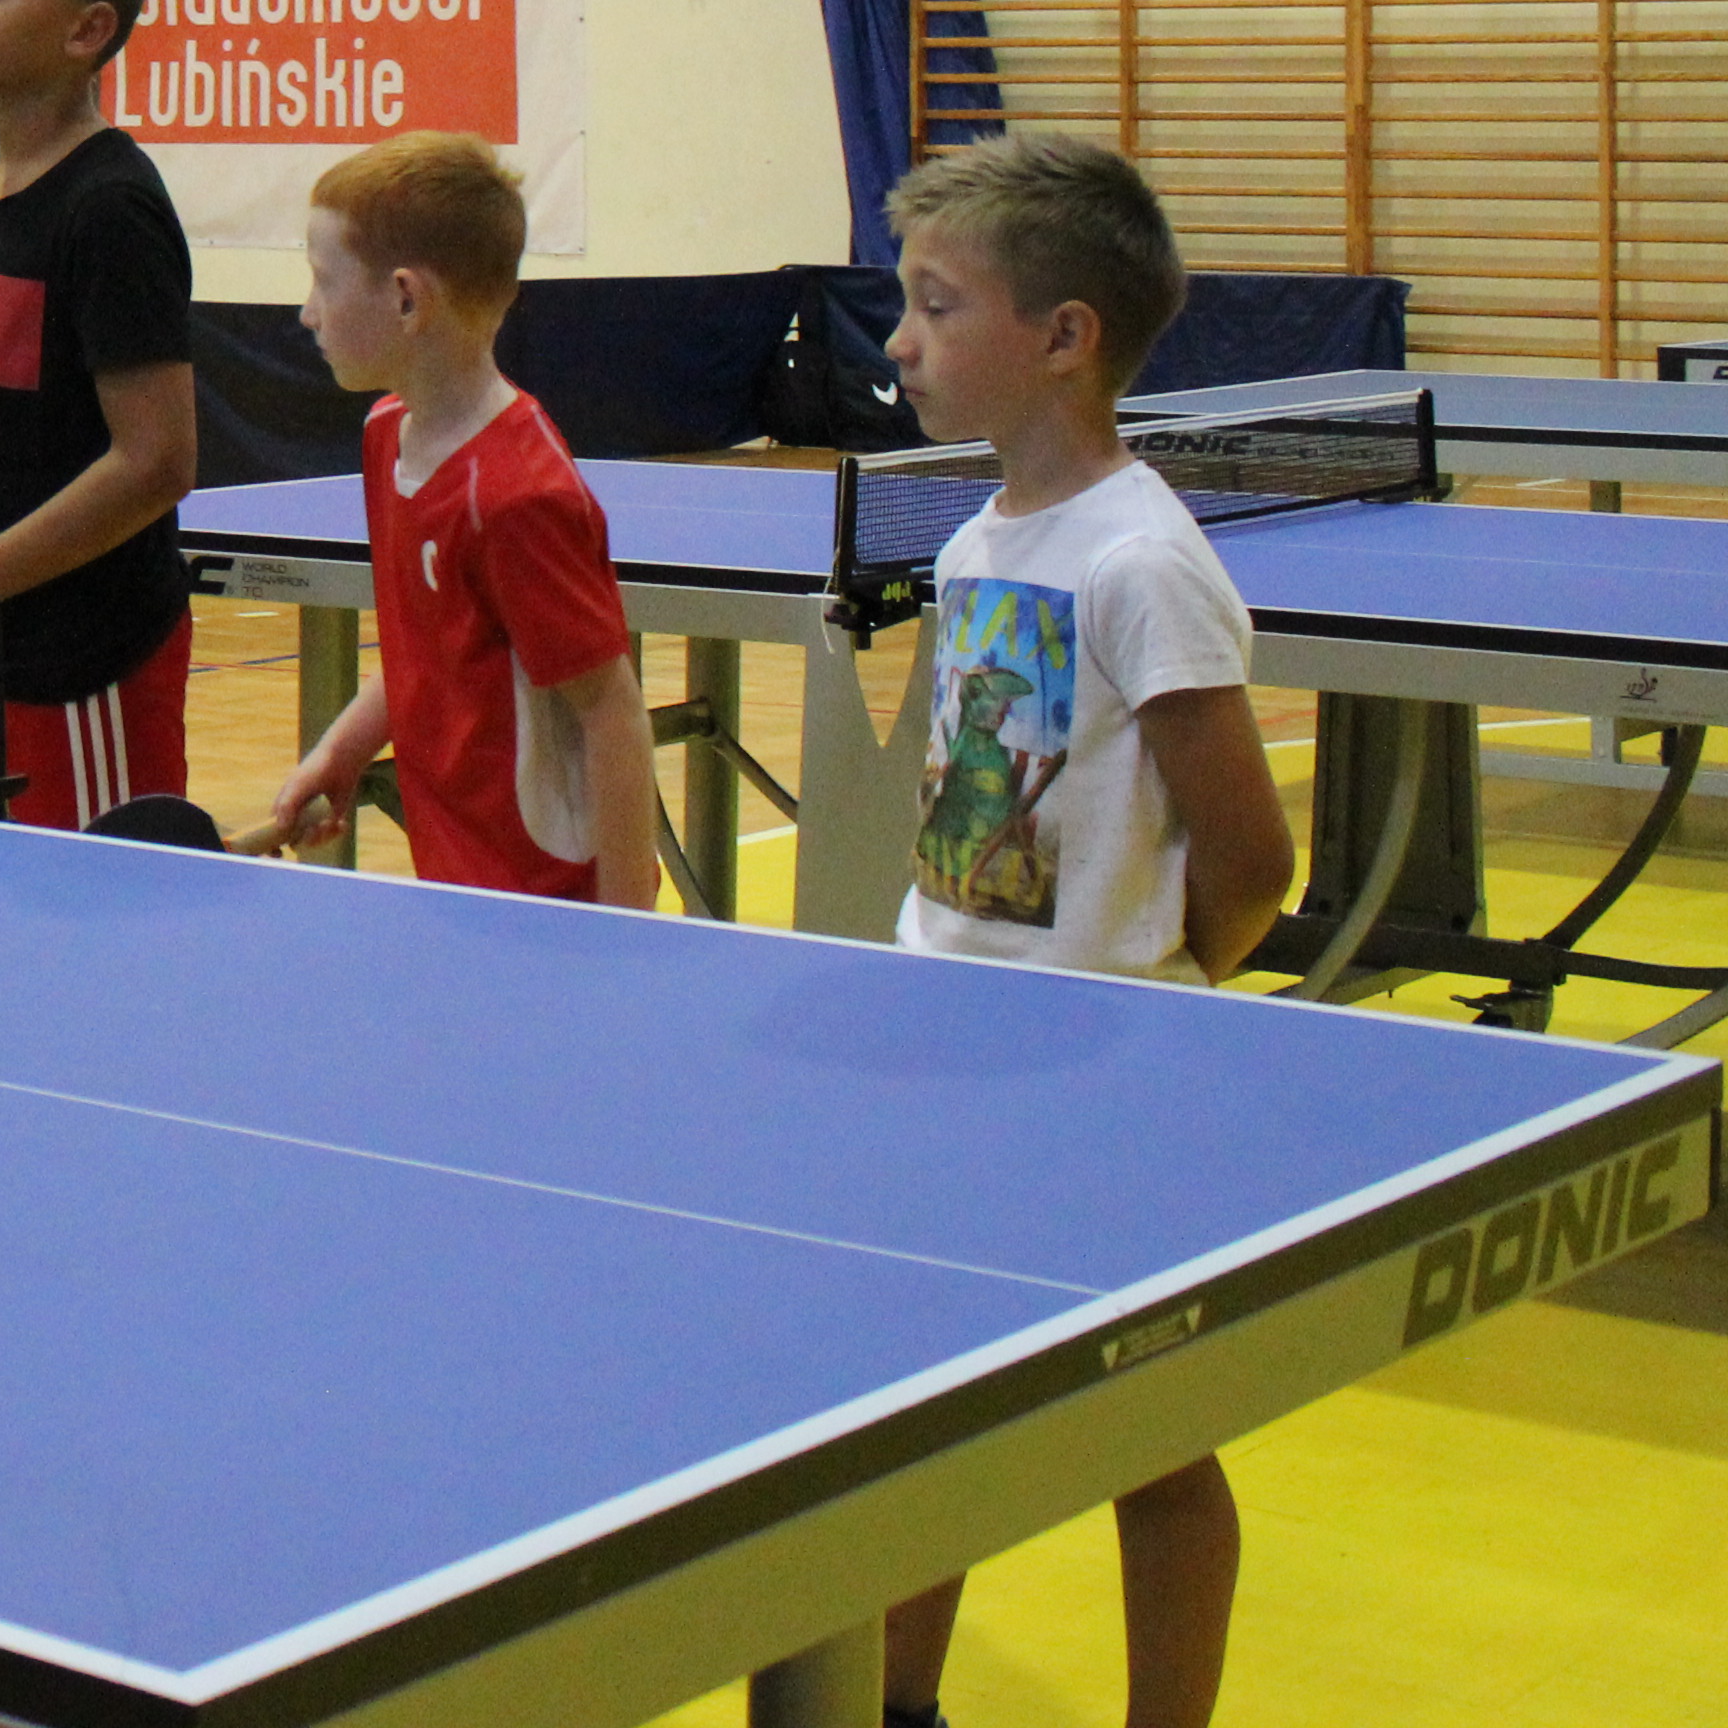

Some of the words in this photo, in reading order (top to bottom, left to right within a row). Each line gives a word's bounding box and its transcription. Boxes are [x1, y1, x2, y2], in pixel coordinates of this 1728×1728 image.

[112, 36, 405, 128] Lubińskie
[240, 562, 288, 575] WORLD
[240, 573, 311, 588] CHAMPION
[940, 588, 1068, 670] LAX
[1400, 1134, 1682, 1350] DONIC
